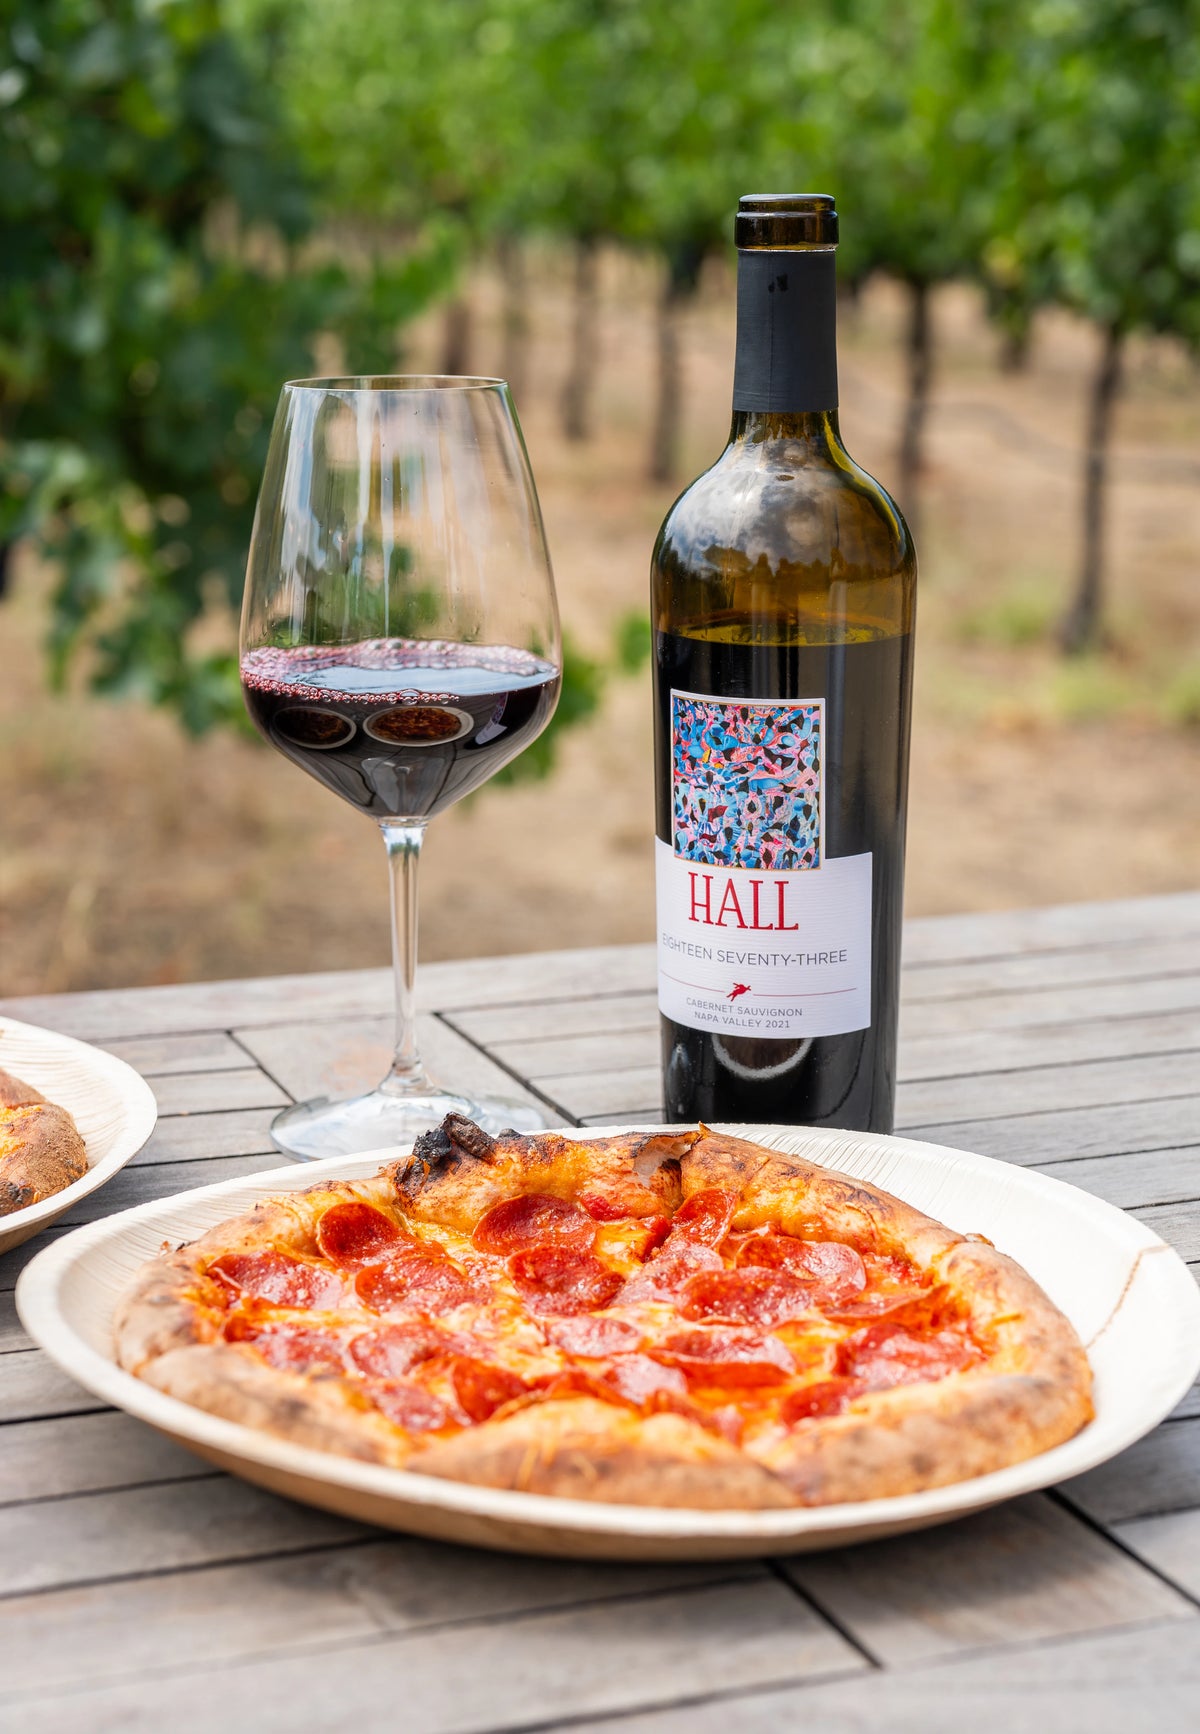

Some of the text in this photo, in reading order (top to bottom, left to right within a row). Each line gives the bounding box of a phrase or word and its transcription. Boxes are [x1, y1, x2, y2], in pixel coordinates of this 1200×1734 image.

[688, 871, 799, 931] HALL
[662, 933, 848, 967] EIGHTEEN SEVENTY-THREE
[686, 997, 803, 1017] CABERNET SAUVIGNON
[694, 1011, 790, 1029] NAPA VALLEY 2021
